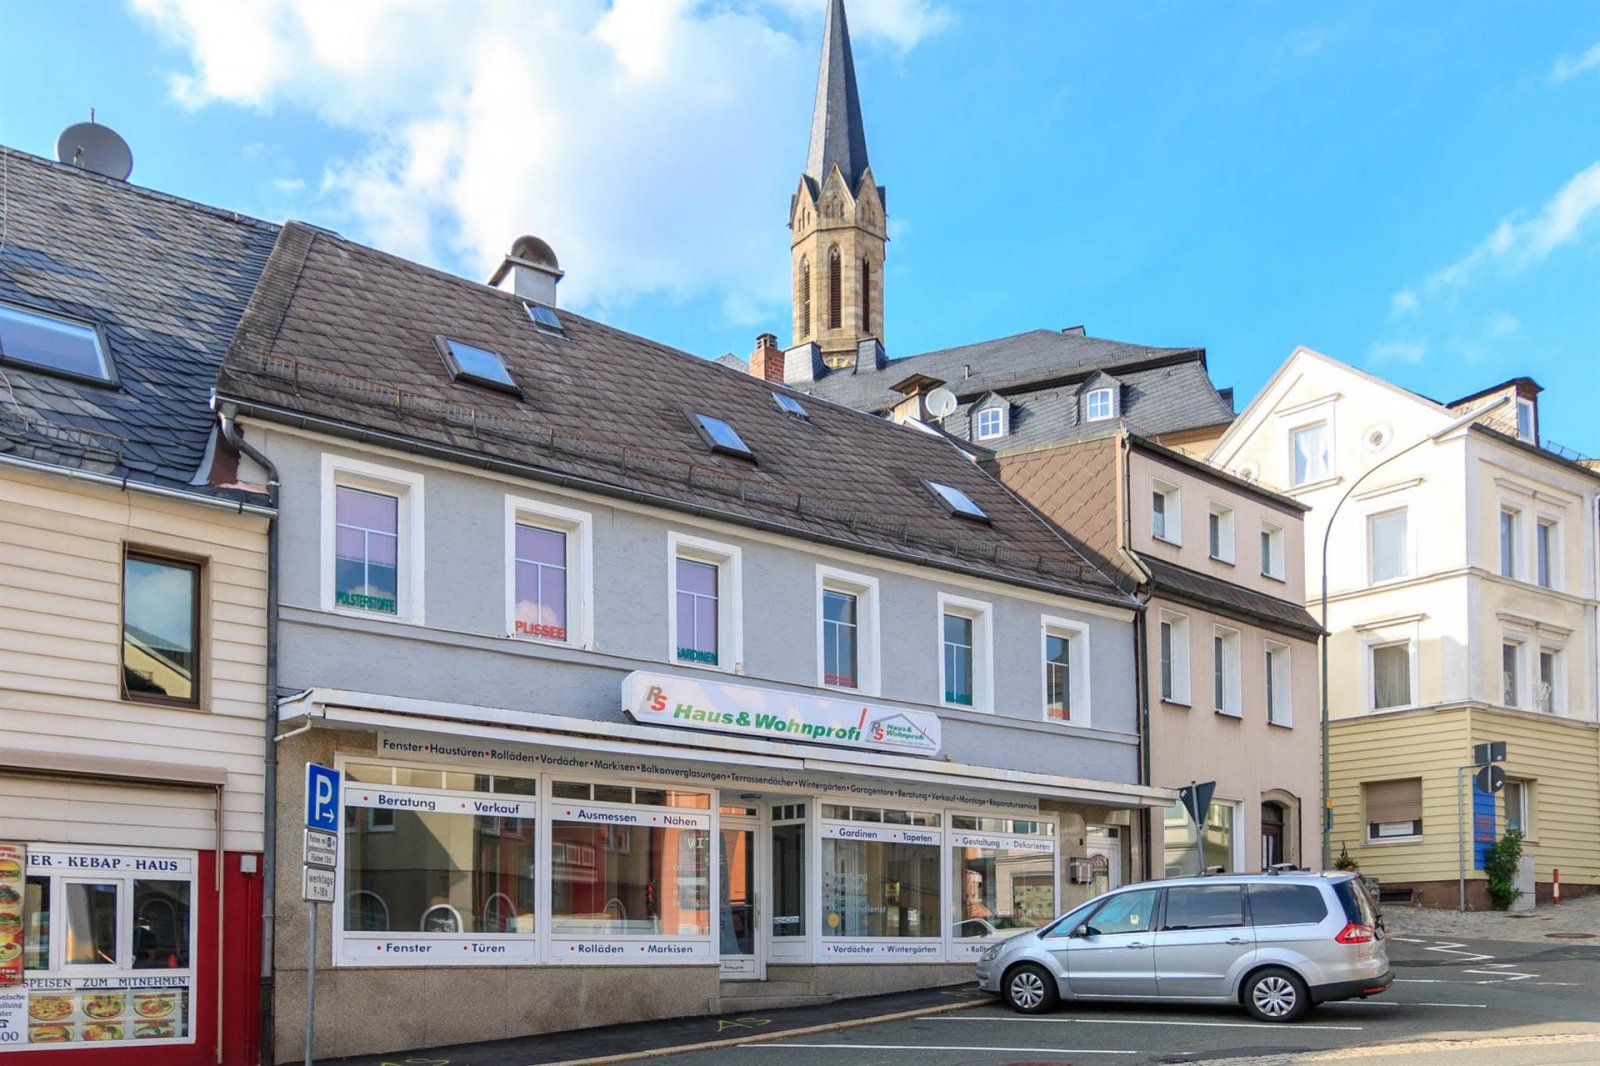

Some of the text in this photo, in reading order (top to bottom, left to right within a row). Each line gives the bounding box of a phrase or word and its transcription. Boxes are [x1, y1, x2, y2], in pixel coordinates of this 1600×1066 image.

[515, 620, 566, 639] PLISSEE
[383, 739, 1038, 810] Fenster Haustüren Rolläden Vordächer Markisen Balkonverglasungen Terrassendächer Wintergärten Garagentore Beratung Verkauf Montage Reparaturservice
[315, 774, 333, 820] P
[378, 794, 520, 814] Beratung Verkauf
[578, 809, 697, 827] Ausmessen Nähen
[839, 827, 933, 842] Gardinen Tapeten
[962, 837, 1050, 850] Gestaltung Dekorieren
[68, 856, 121, 868] KEBAP
[136, 860, 178, 871] HAUS
[386, 943, 506, 953] Fenster Türen
[578, 944, 693, 953] Rolläden Markisen
[833, 945, 937, 955] Vordächer Wintergärten
[22, 977, 187, 988] SPEISEN ZUM MITNEHMEN
